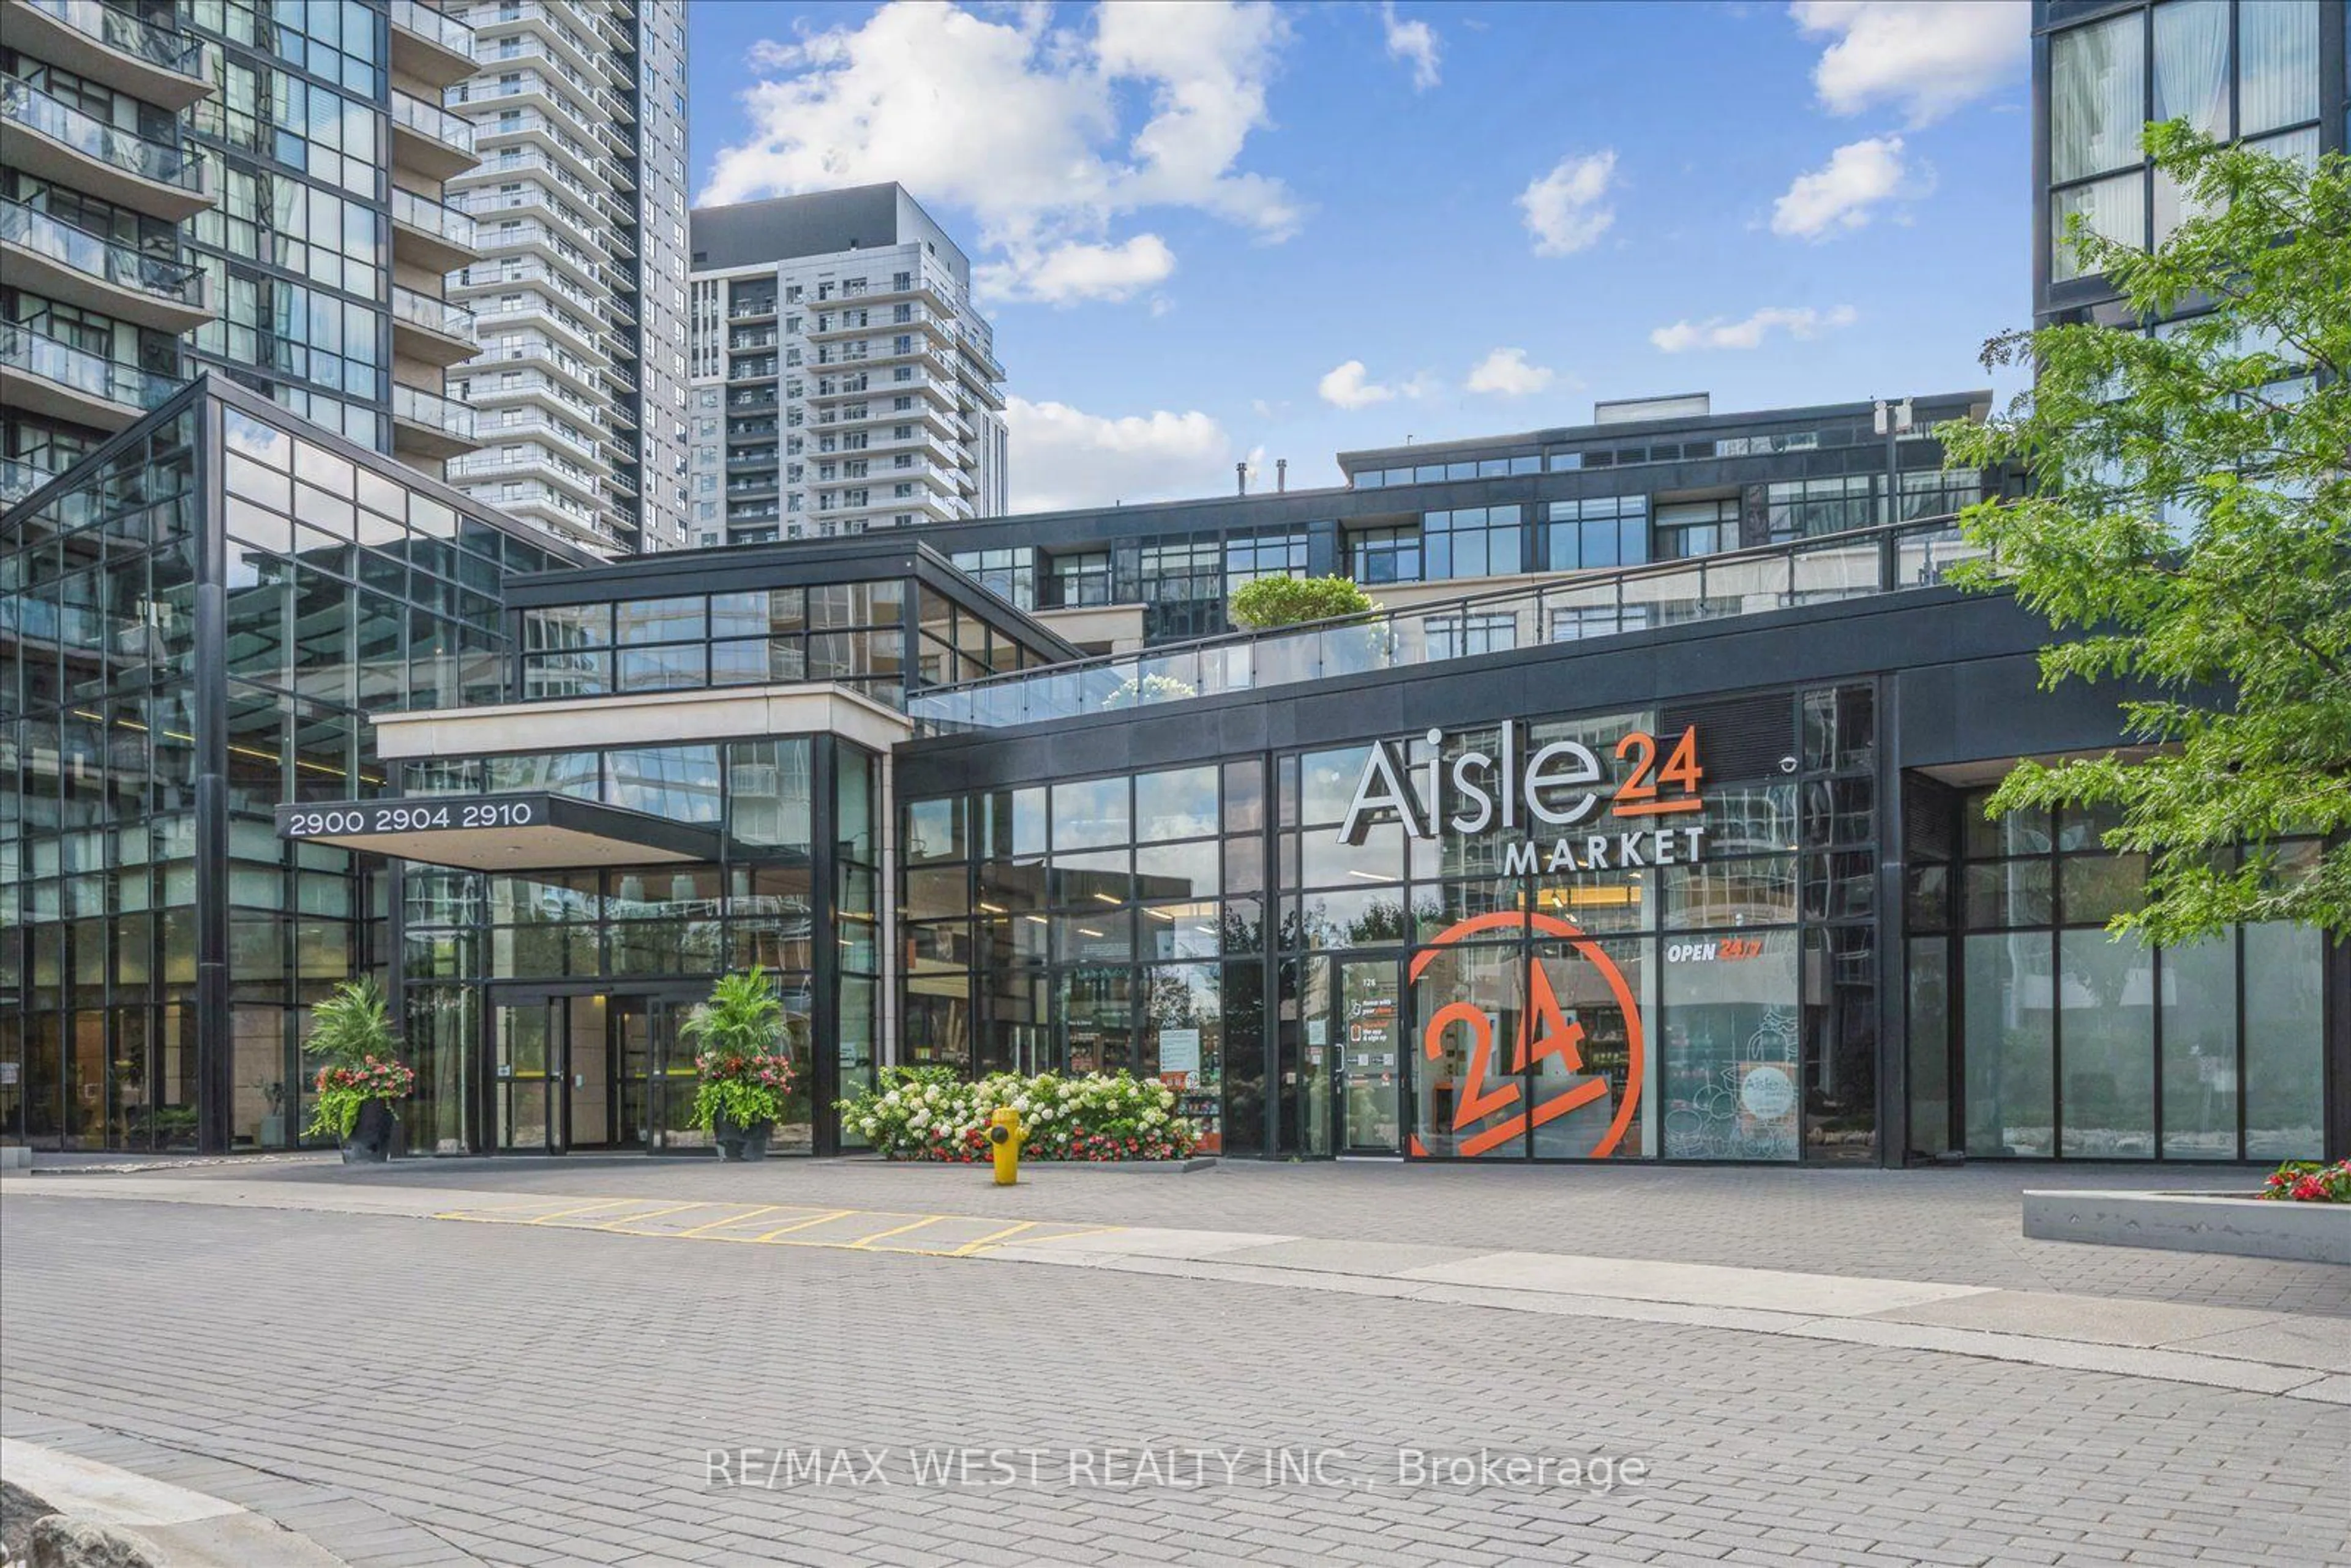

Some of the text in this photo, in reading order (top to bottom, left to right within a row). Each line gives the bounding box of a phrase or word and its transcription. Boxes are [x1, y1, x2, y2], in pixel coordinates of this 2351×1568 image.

[1335, 719, 1702, 844] Aisle 24
[290, 803, 531, 835] 2900 2904 2910
[1504, 827, 1705, 876] MARKET
[1667, 938, 1761, 962] OPEN 24/7
[1425, 958, 1585, 1131] 24
